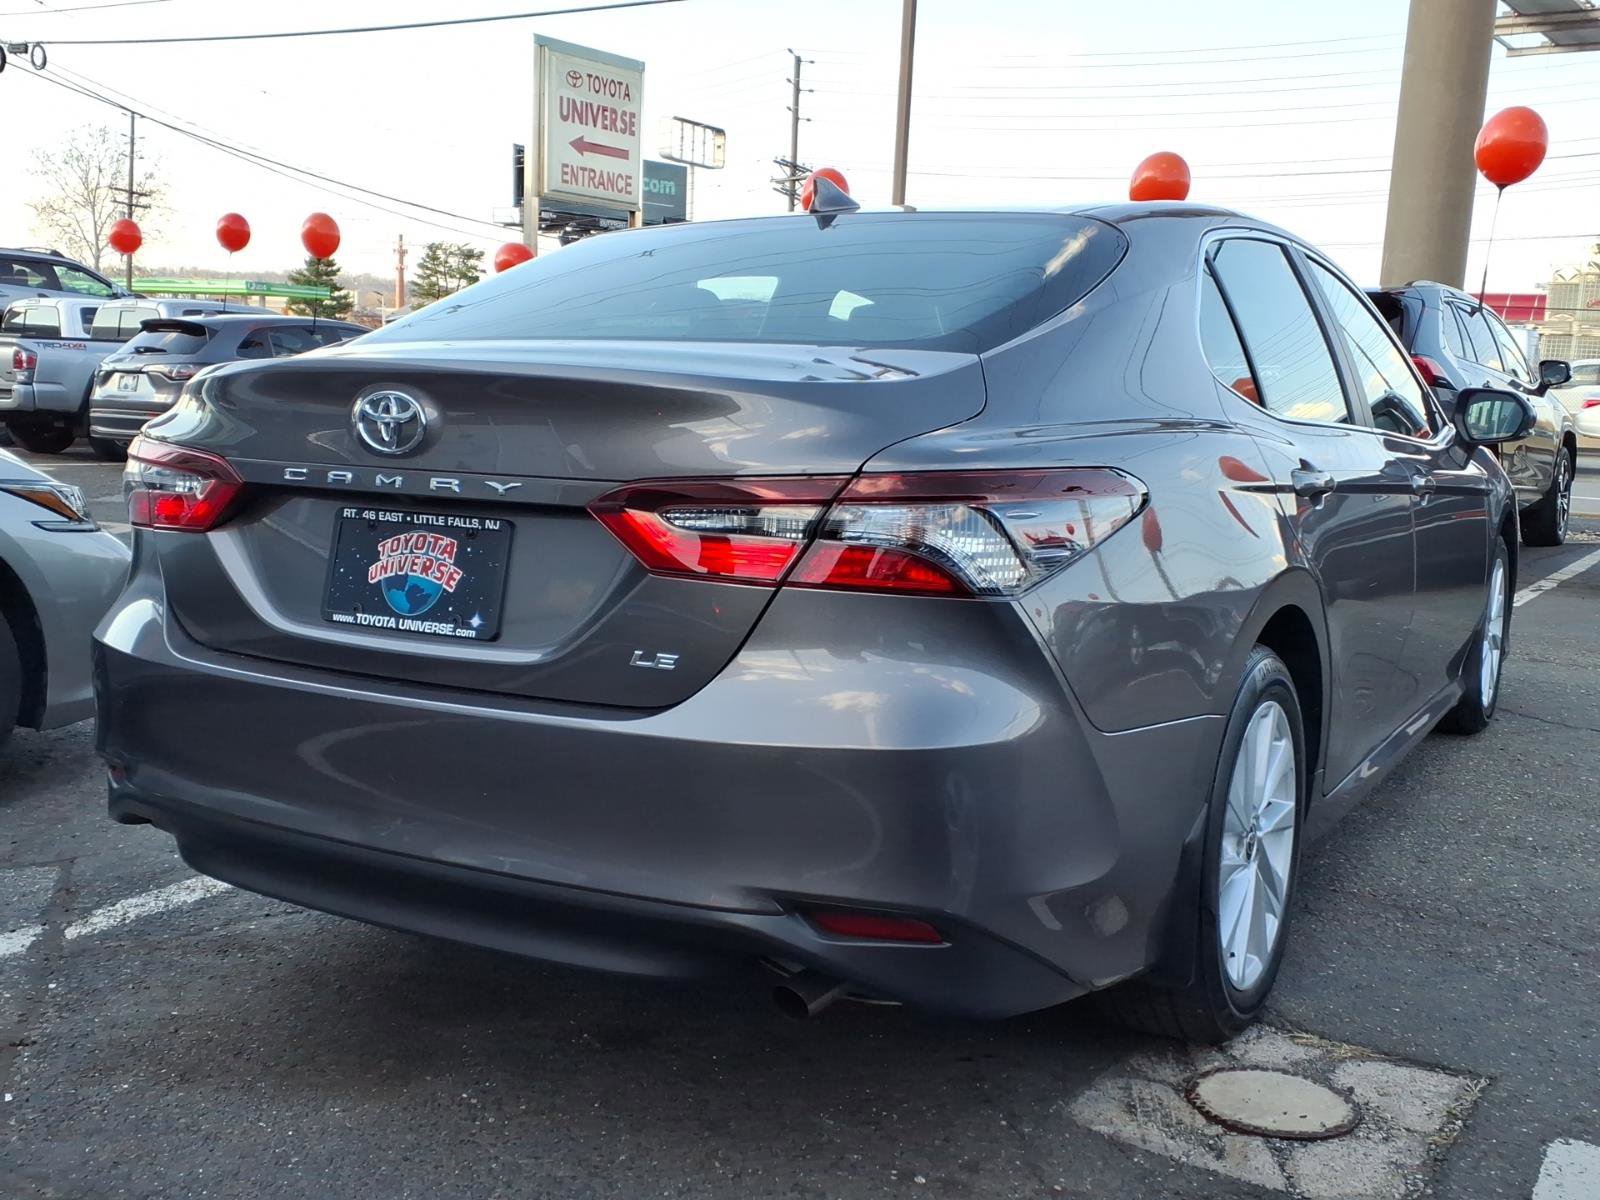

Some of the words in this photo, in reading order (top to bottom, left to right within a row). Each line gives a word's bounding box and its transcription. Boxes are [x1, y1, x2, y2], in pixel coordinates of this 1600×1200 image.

[586, 73, 631, 102] TOYOTA
[559, 95, 636, 137] UNIVERSE
[561, 163, 633, 196] ENTRANCE
[283, 467, 523, 496] CAMRY
[343, 508, 360, 519] RT.
[362, 510, 377, 520] 46
[378, 511, 404, 522] EAST
[413, 514, 446, 526] LITTLE
[447, 516, 482, 530] FALLS,
[485, 519, 500, 530] NJ
[378, 532, 458, 563] TOYOTA
[368, 553, 463, 593] UNIVERSE
[629, 650, 680, 671] LE
